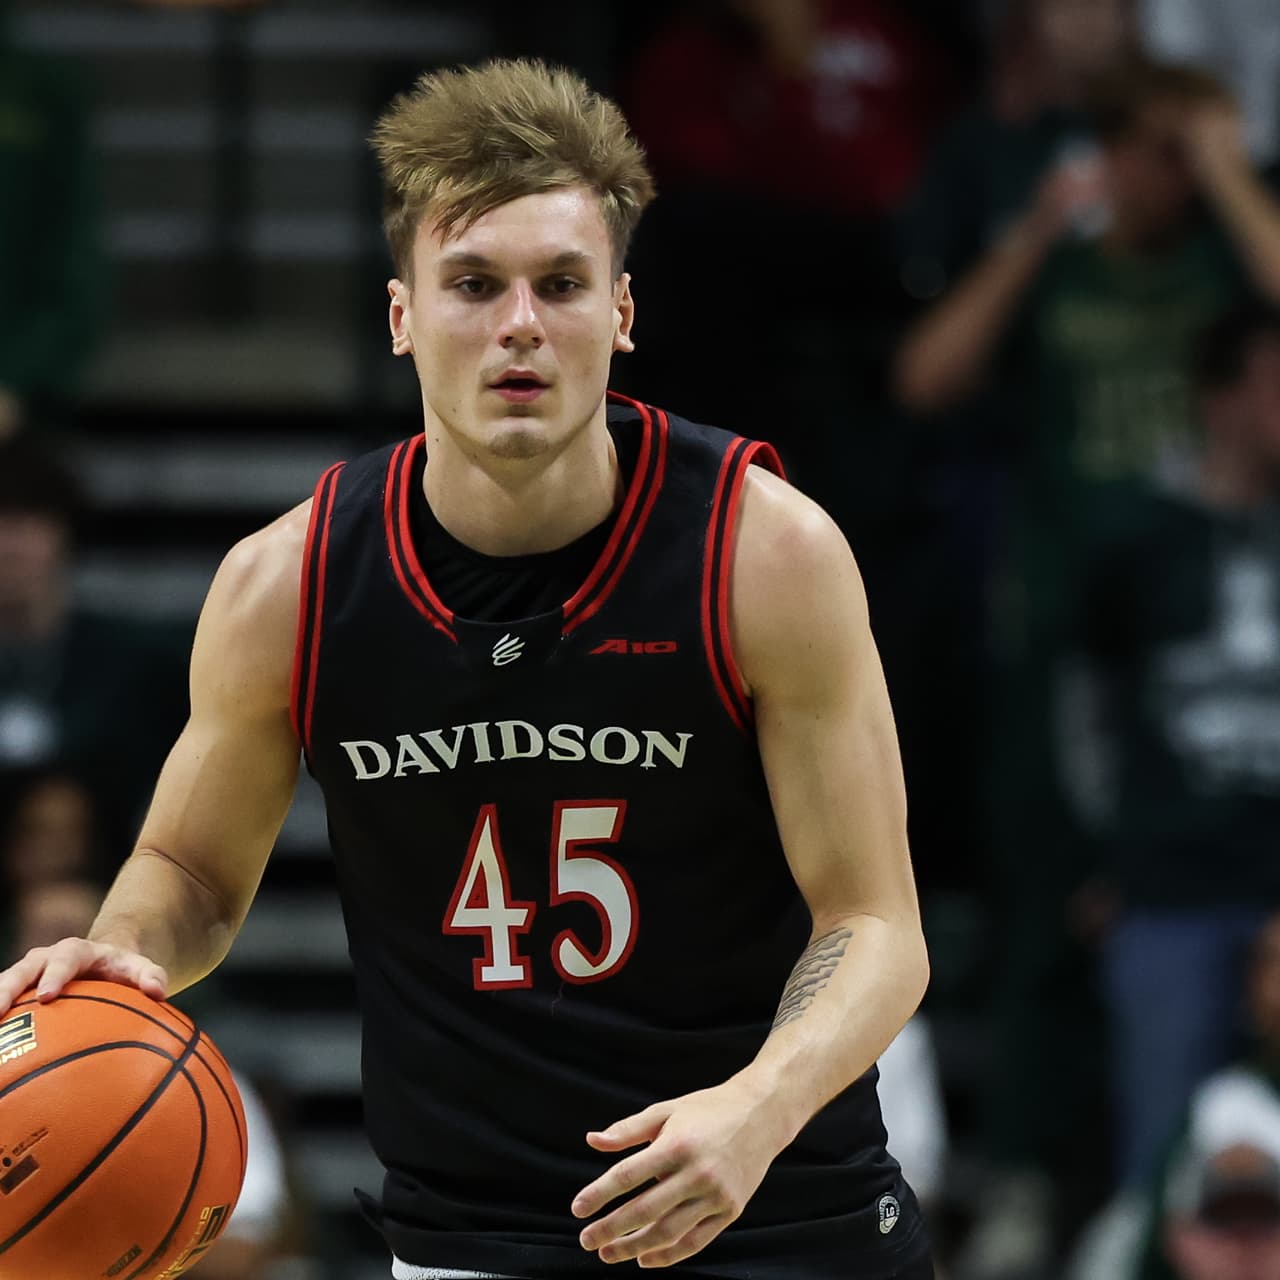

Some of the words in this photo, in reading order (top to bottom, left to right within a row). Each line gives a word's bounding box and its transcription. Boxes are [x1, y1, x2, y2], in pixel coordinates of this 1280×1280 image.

[588, 639, 677, 654] A10
[340, 720, 693, 780] DAVIDSON
[442, 799, 639, 991] 45
